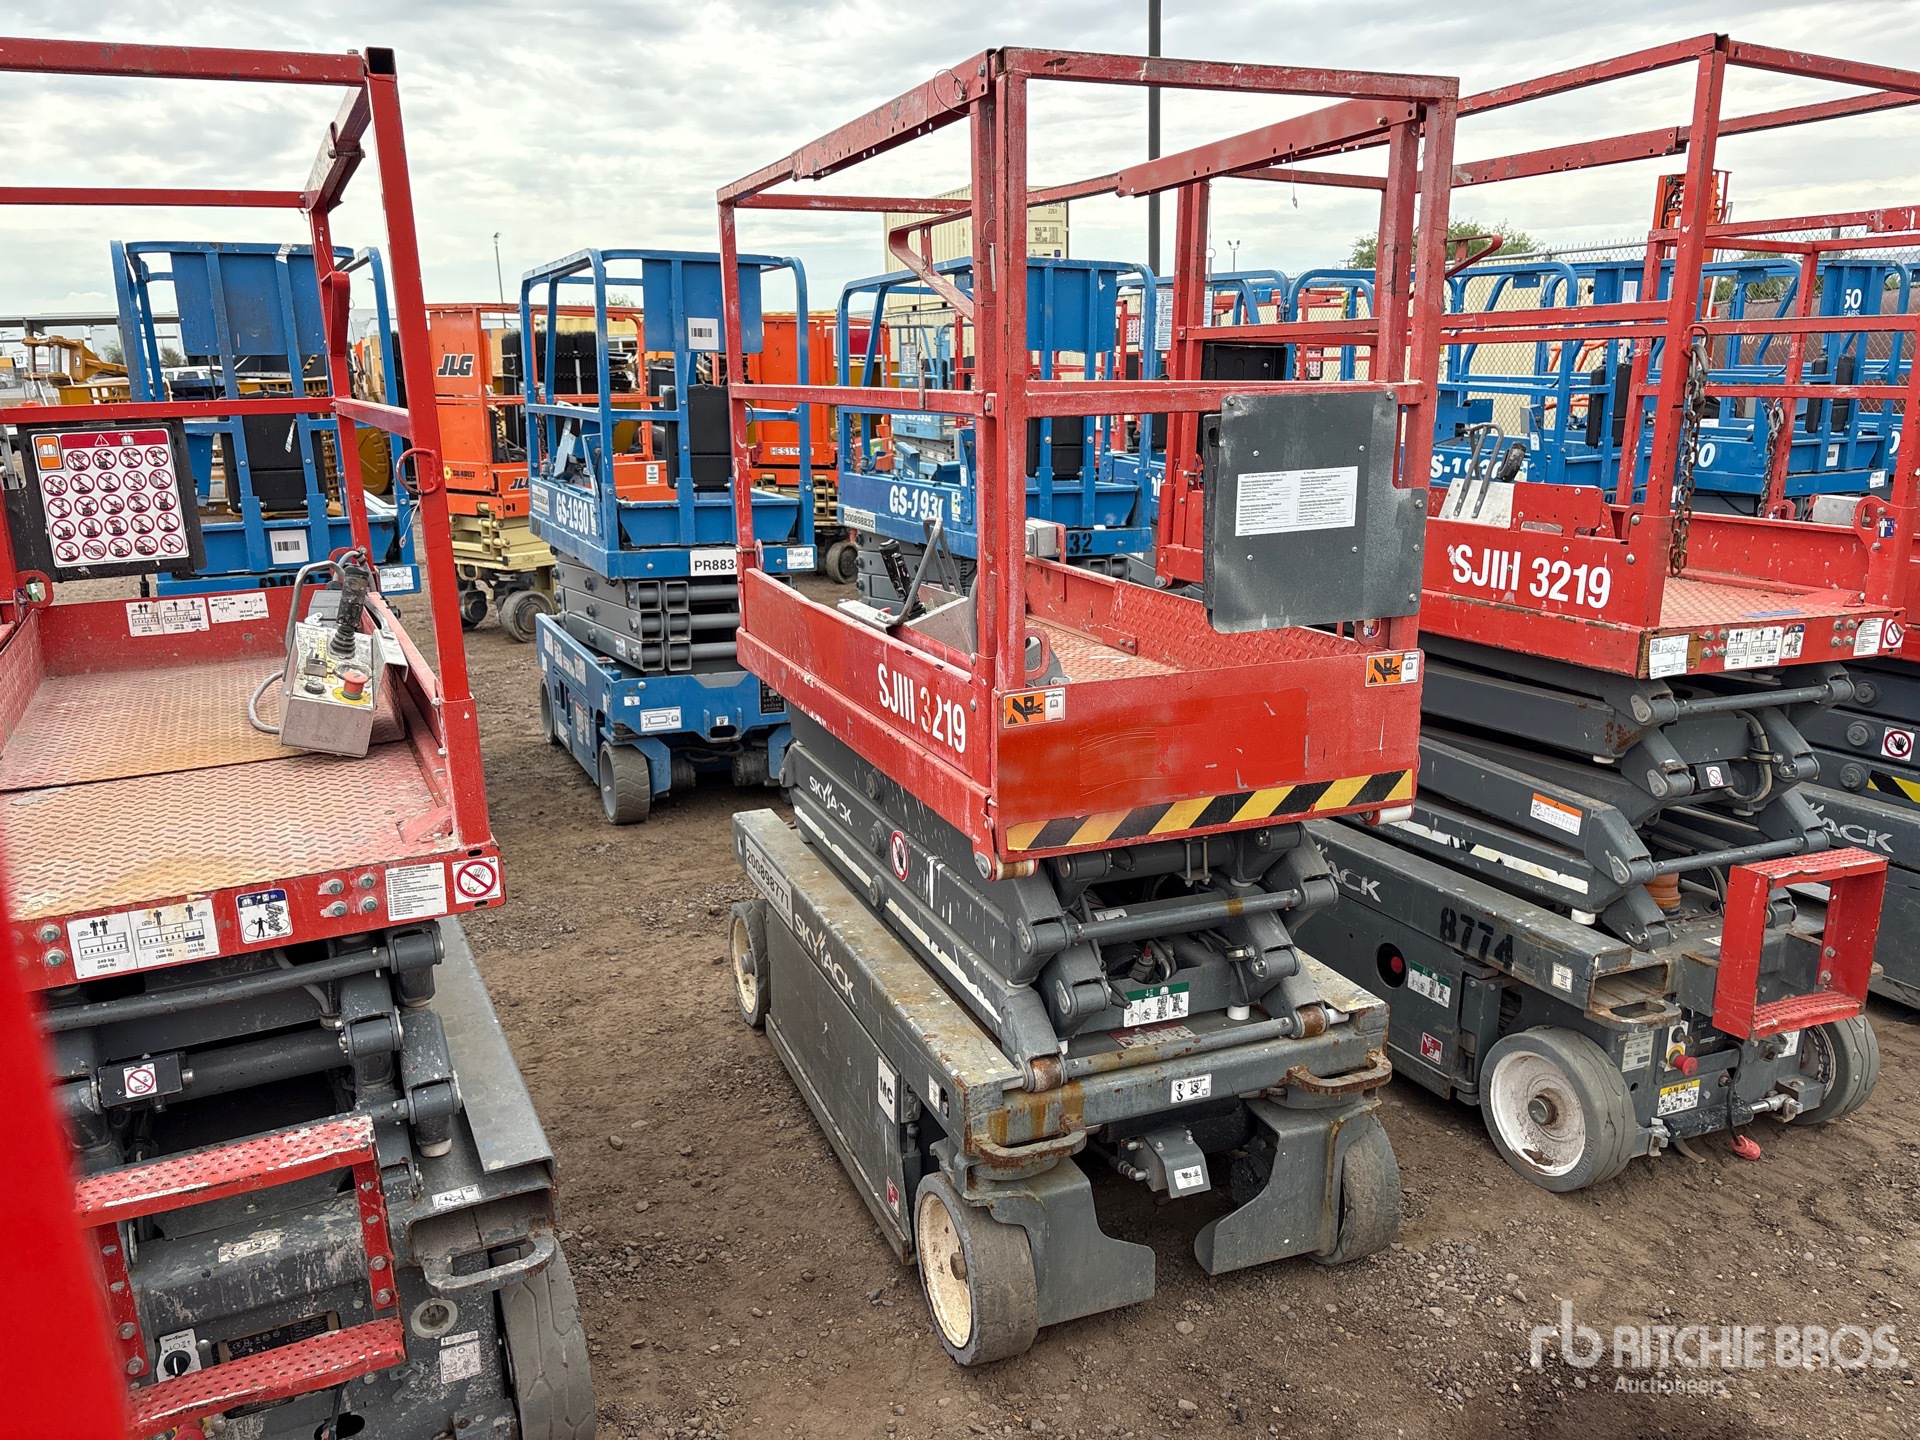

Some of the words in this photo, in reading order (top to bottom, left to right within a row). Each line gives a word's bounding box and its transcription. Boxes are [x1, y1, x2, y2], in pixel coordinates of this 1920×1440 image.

[436, 354, 474, 377] JLG
[556, 492, 588, 536] GS-1930
[844, 512, 875, 529] 200898832
[1068, 532, 1093, 554] 32
[1529, 556, 1611, 609] 3219
[877, 662, 916, 725] SJIII
[920, 686, 966, 754] 3219
[746, 848, 790, 910] 200898771
[794, 913, 857, 1009] SKYJACK
[1439, 906, 1514, 970] 8774
